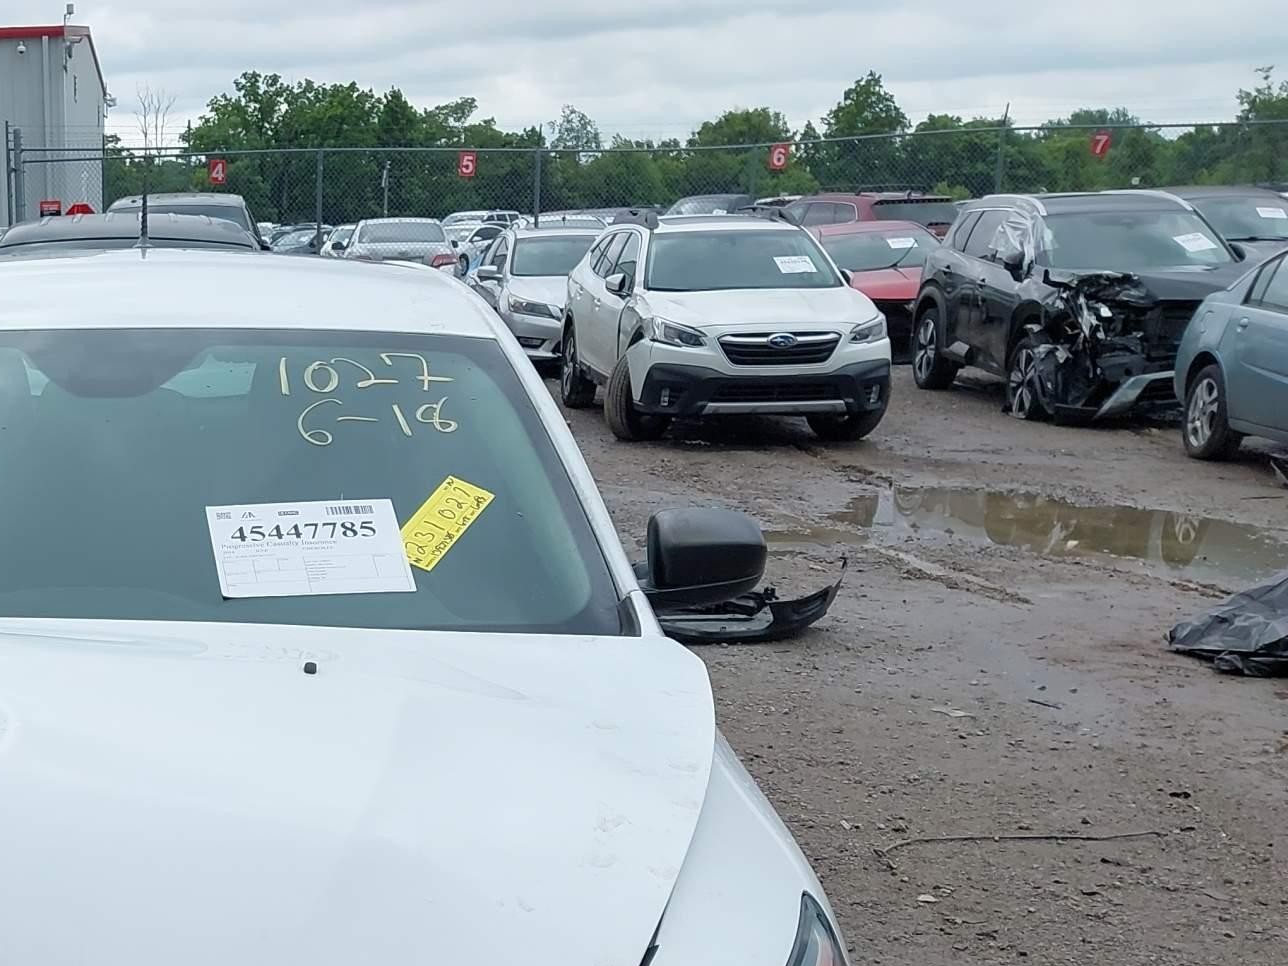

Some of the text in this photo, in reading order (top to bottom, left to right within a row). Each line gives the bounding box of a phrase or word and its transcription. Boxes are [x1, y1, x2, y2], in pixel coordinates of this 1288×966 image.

[1095, 135, 1109, 154] 7
[462, 155, 474, 174] 5
[773, 148, 785, 166] 6
[211, 162, 225, 181] 4
[279, 352, 455, 396] 1027
[297, 396, 459, 446] 6-18
[230, 520, 377, 543] 45447785
